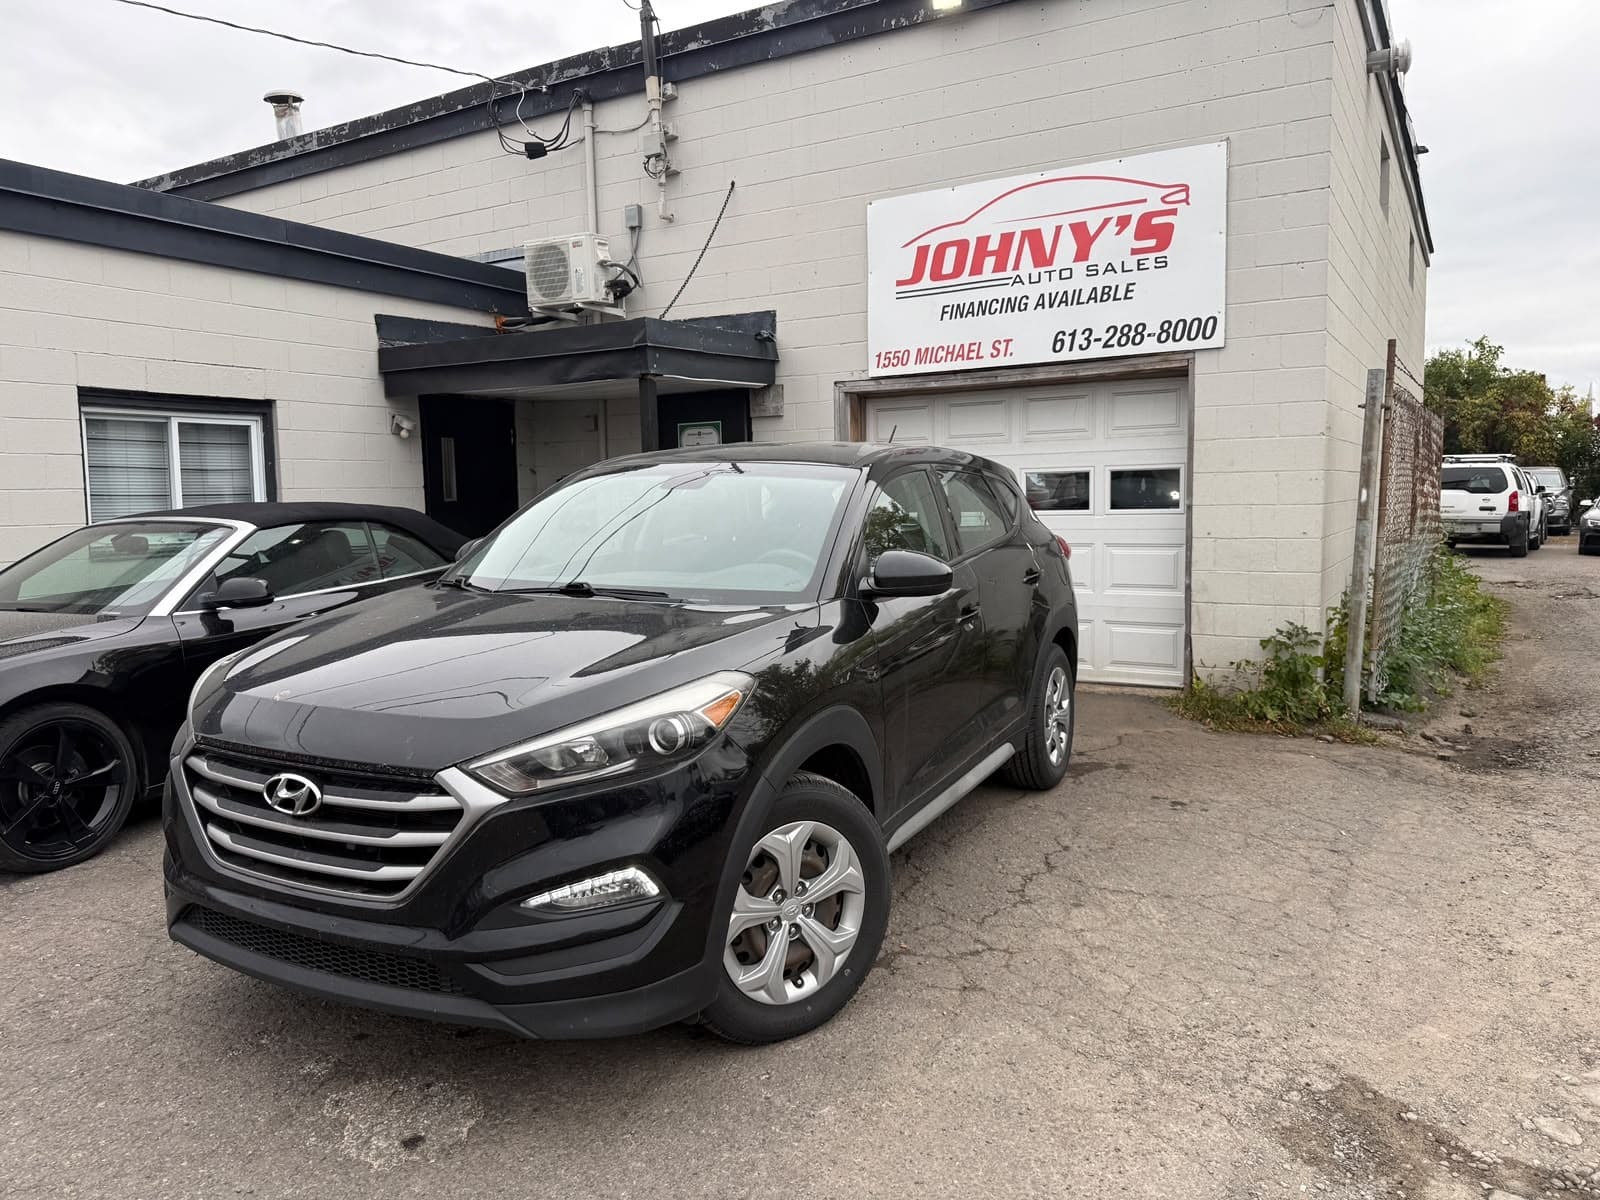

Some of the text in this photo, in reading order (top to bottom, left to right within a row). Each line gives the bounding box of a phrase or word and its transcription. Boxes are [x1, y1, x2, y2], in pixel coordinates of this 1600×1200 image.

[896, 208, 1178, 287] JOHNY'S
[1011, 255, 1168, 287] AUTO SALES
[940, 282, 1136, 321] FINANCING AVAILABLE
[874, 338, 1014, 369] 1550 MICHAEL ST.
[1051, 316, 1218, 354] 613-288-8000
